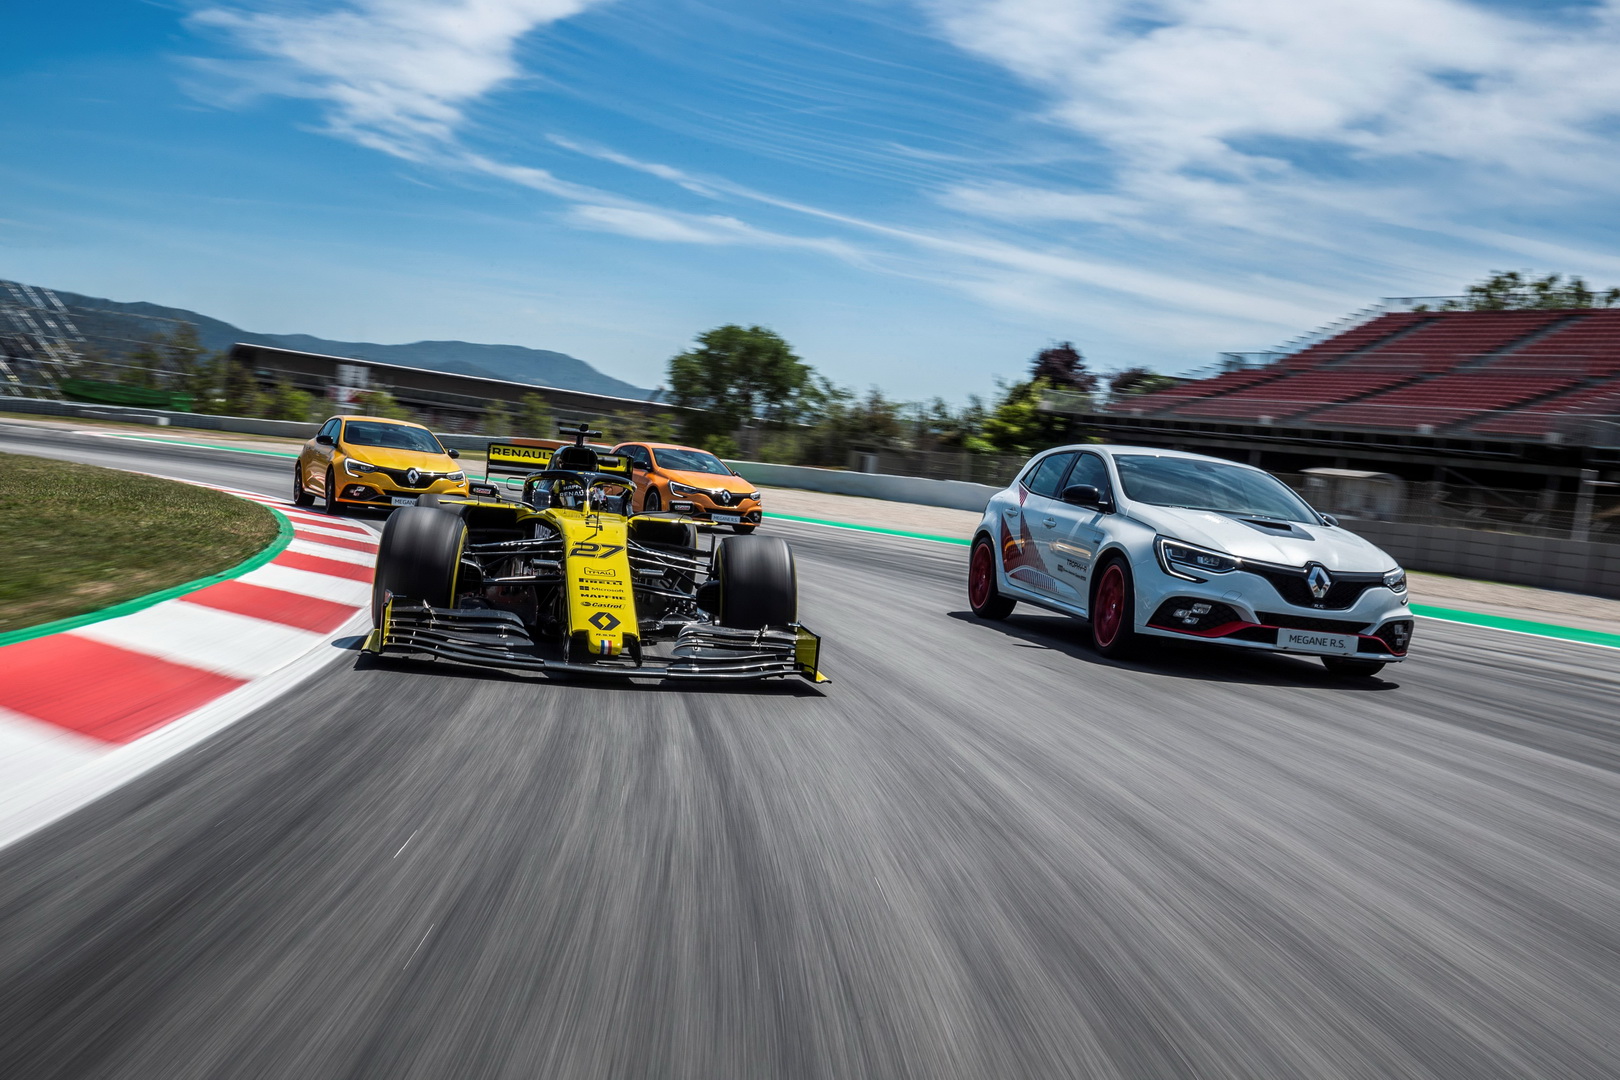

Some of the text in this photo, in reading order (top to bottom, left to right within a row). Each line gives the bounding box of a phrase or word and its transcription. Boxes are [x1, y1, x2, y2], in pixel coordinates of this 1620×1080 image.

[568, 541, 625, 558] 27
[1288, 634, 1346, 649] MEGANE R.S.
